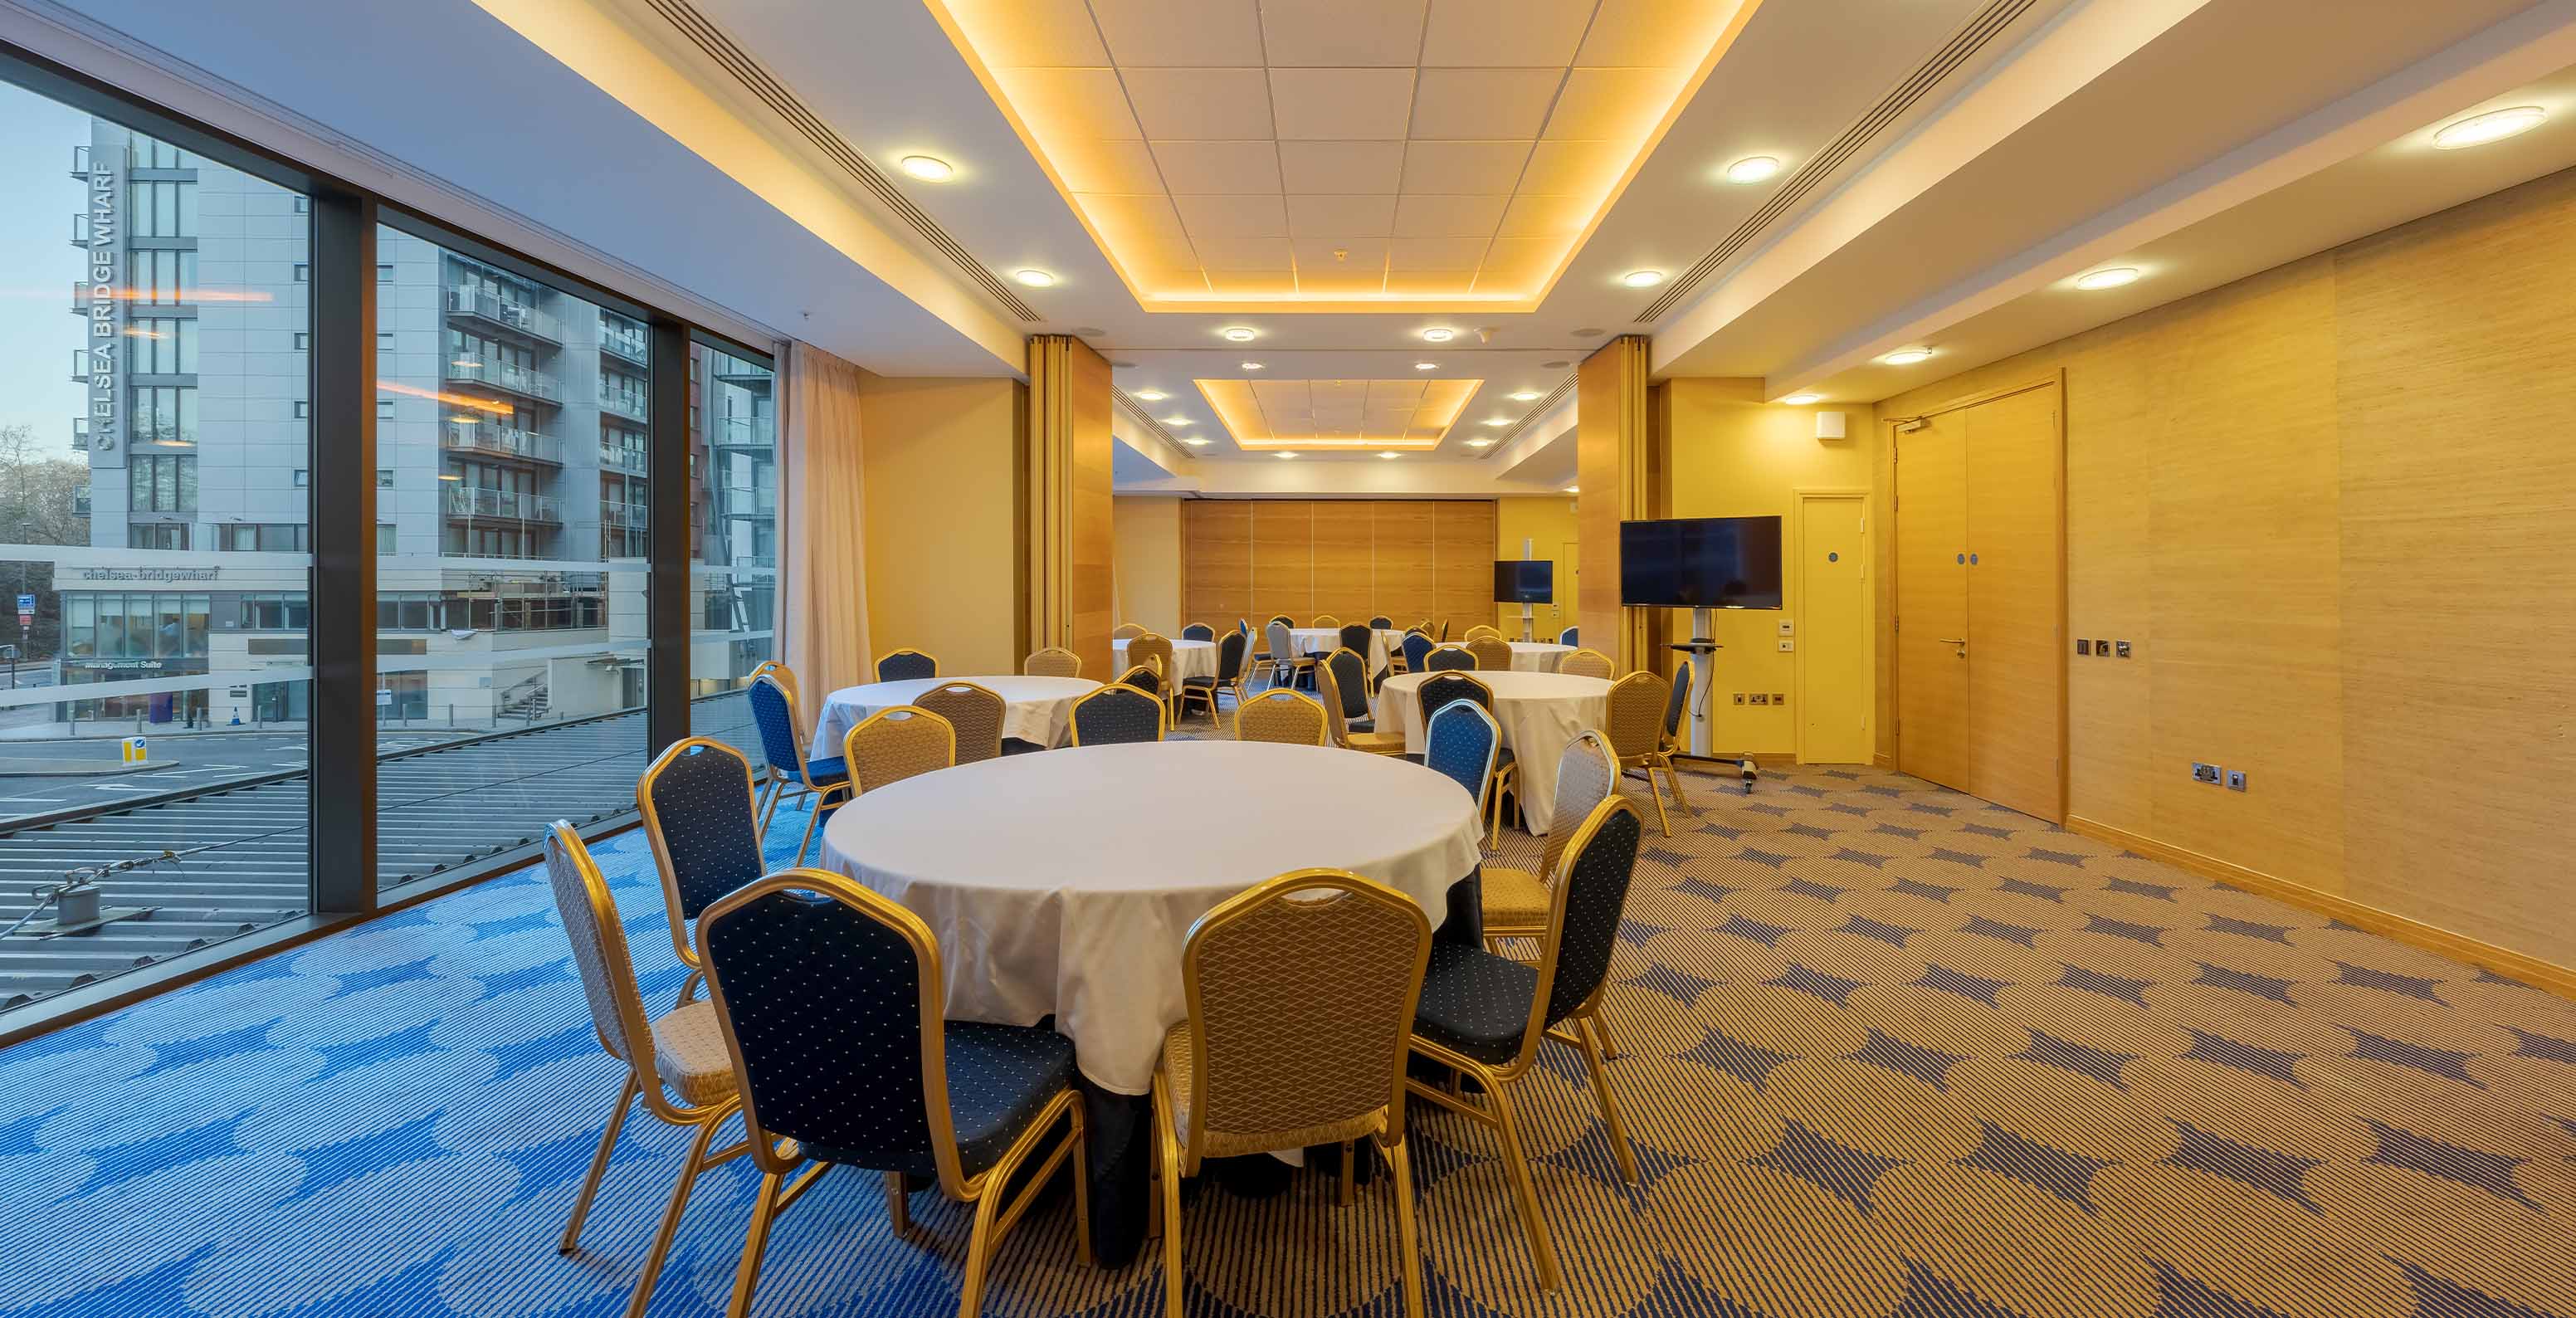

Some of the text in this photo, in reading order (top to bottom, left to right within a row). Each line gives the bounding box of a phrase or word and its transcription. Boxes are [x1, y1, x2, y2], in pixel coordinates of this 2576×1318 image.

[93, 162, 114, 451] CHELSEA BRIDGE WHARF
